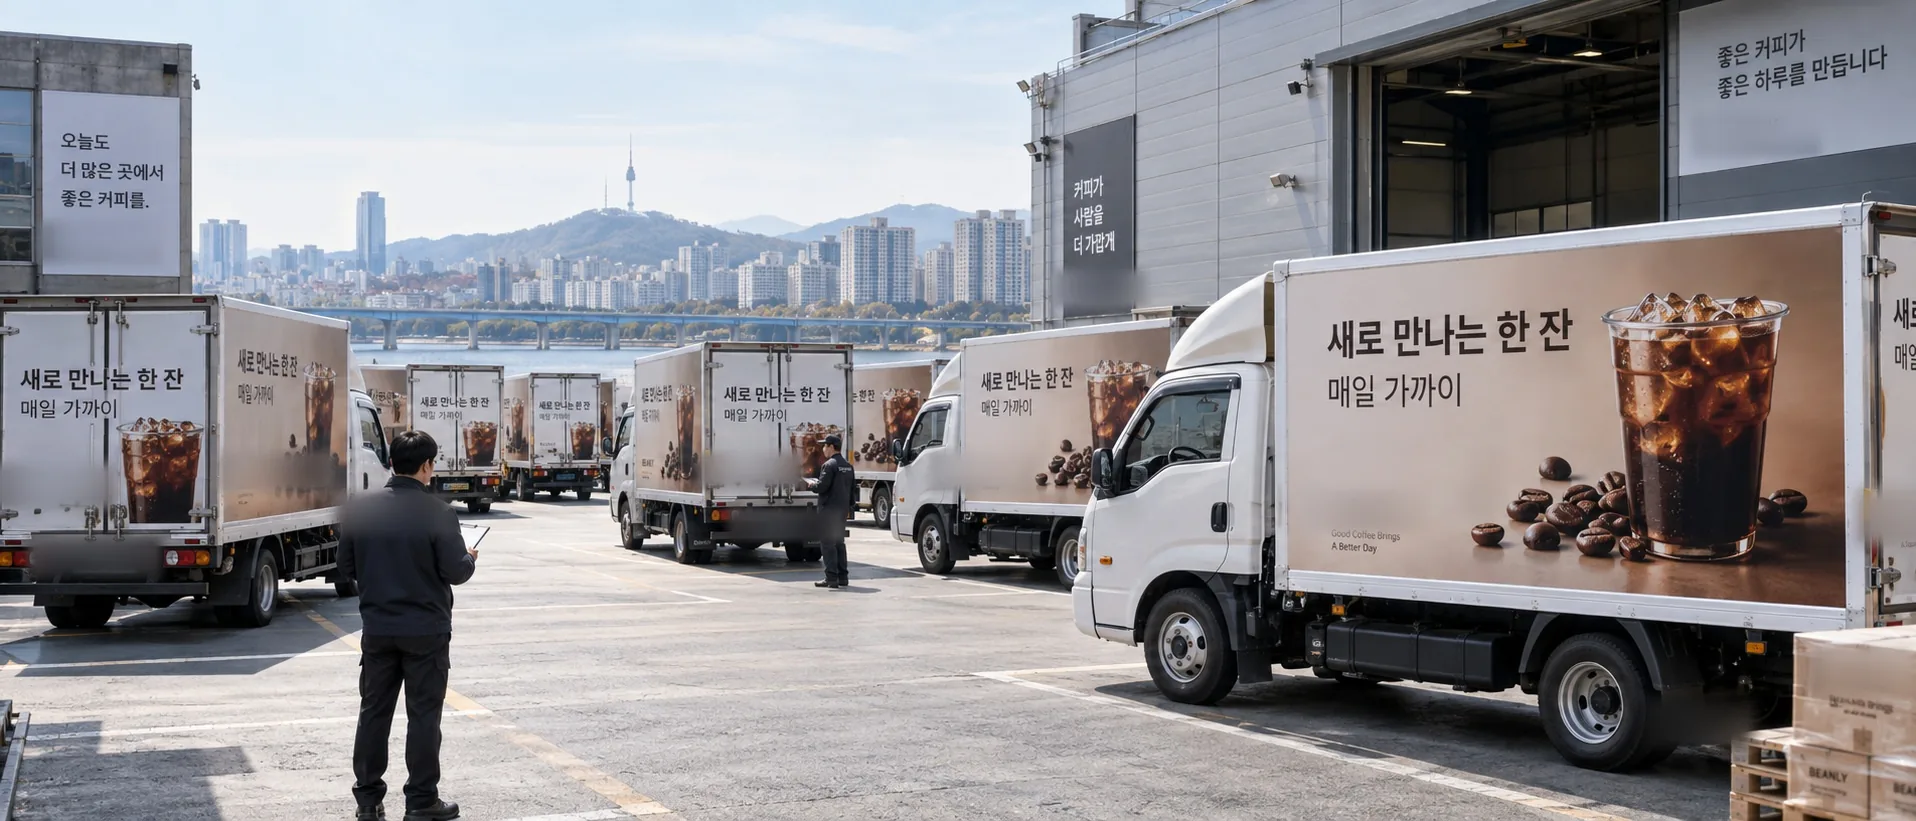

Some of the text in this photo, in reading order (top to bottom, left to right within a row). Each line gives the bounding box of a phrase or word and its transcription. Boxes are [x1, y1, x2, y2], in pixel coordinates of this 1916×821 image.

[1717, 29, 1806, 69] 좋은 커피가
[1717, 44, 1888, 100] 좋은 하루를 만듭니다
[60, 133, 110, 151] 오늘도
[61, 161, 164, 182] 더 많은 곳에서
[1073, 175, 1104, 200] 커피가
[60, 189, 150, 209] 좋은 커피를.
[1073, 204, 1104, 228] 사람을
[1073, 230, 1115, 256] 더 가깝게
[1327, 308, 1573, 359] 새로 만나는 한 잔
[238, 349, 298, 378] 새로 만나는 한 잔
[20, 368, 184, 391] 새로 만나는 한 잔
[981, 366, 1073, 392] 새로 만나는 한 잔
[237, 383, 274, 406] 매일 가까이
[724, 386, 830, 403] 새로 만나는 한 잔
[1328, 372, 1461, 408] 매일 가까이
[20, 399, 118, 419] 매일 가까이
[470, 396, 479, 408] 한
[981, 398, 1032, 416] 매일 가까이
[724, 408, 787, 422] 매일 가까이
[1331, 529, 1400, 542] Good Coffee Brings
[1331, 542, 1378, 555] A Better Day
[1809, 766, 1849, 783] BEANLY
[1892, 781, 1916, 796] BEA
